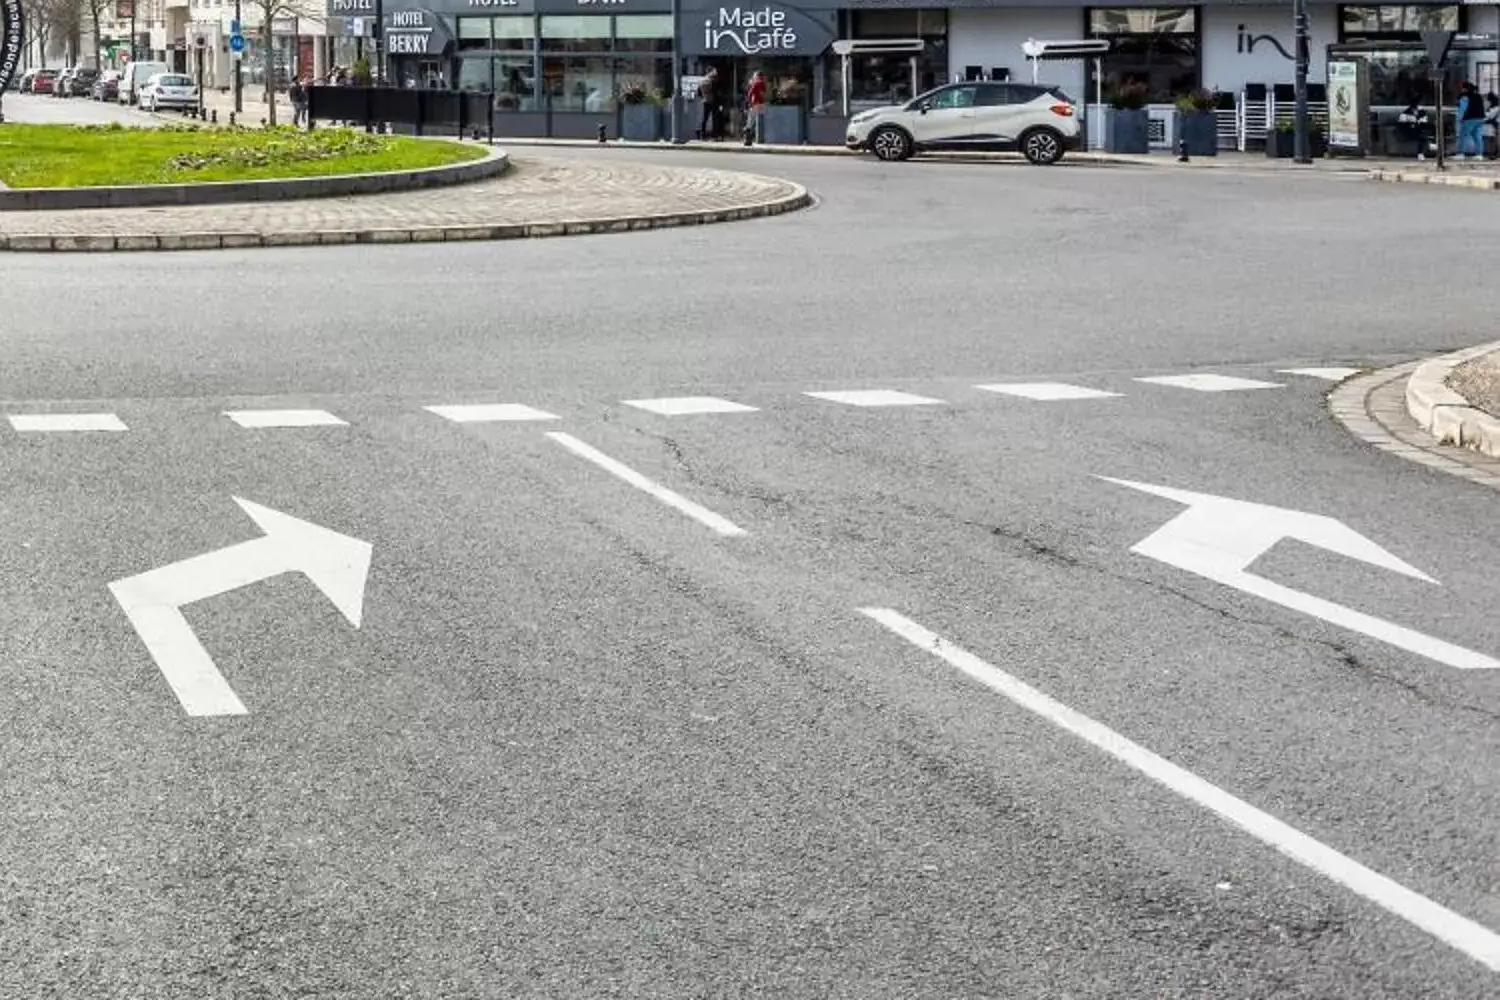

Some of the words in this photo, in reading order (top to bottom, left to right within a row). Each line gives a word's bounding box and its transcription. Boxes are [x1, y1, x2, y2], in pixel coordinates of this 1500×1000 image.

[393, 12, 424, 25] HOTEL
[719, 7, 785, 27] Made
[389, 34, 429, 53] BERRY
[705, 20, 758, 54] in
[744, 27, 797, 49] Café
